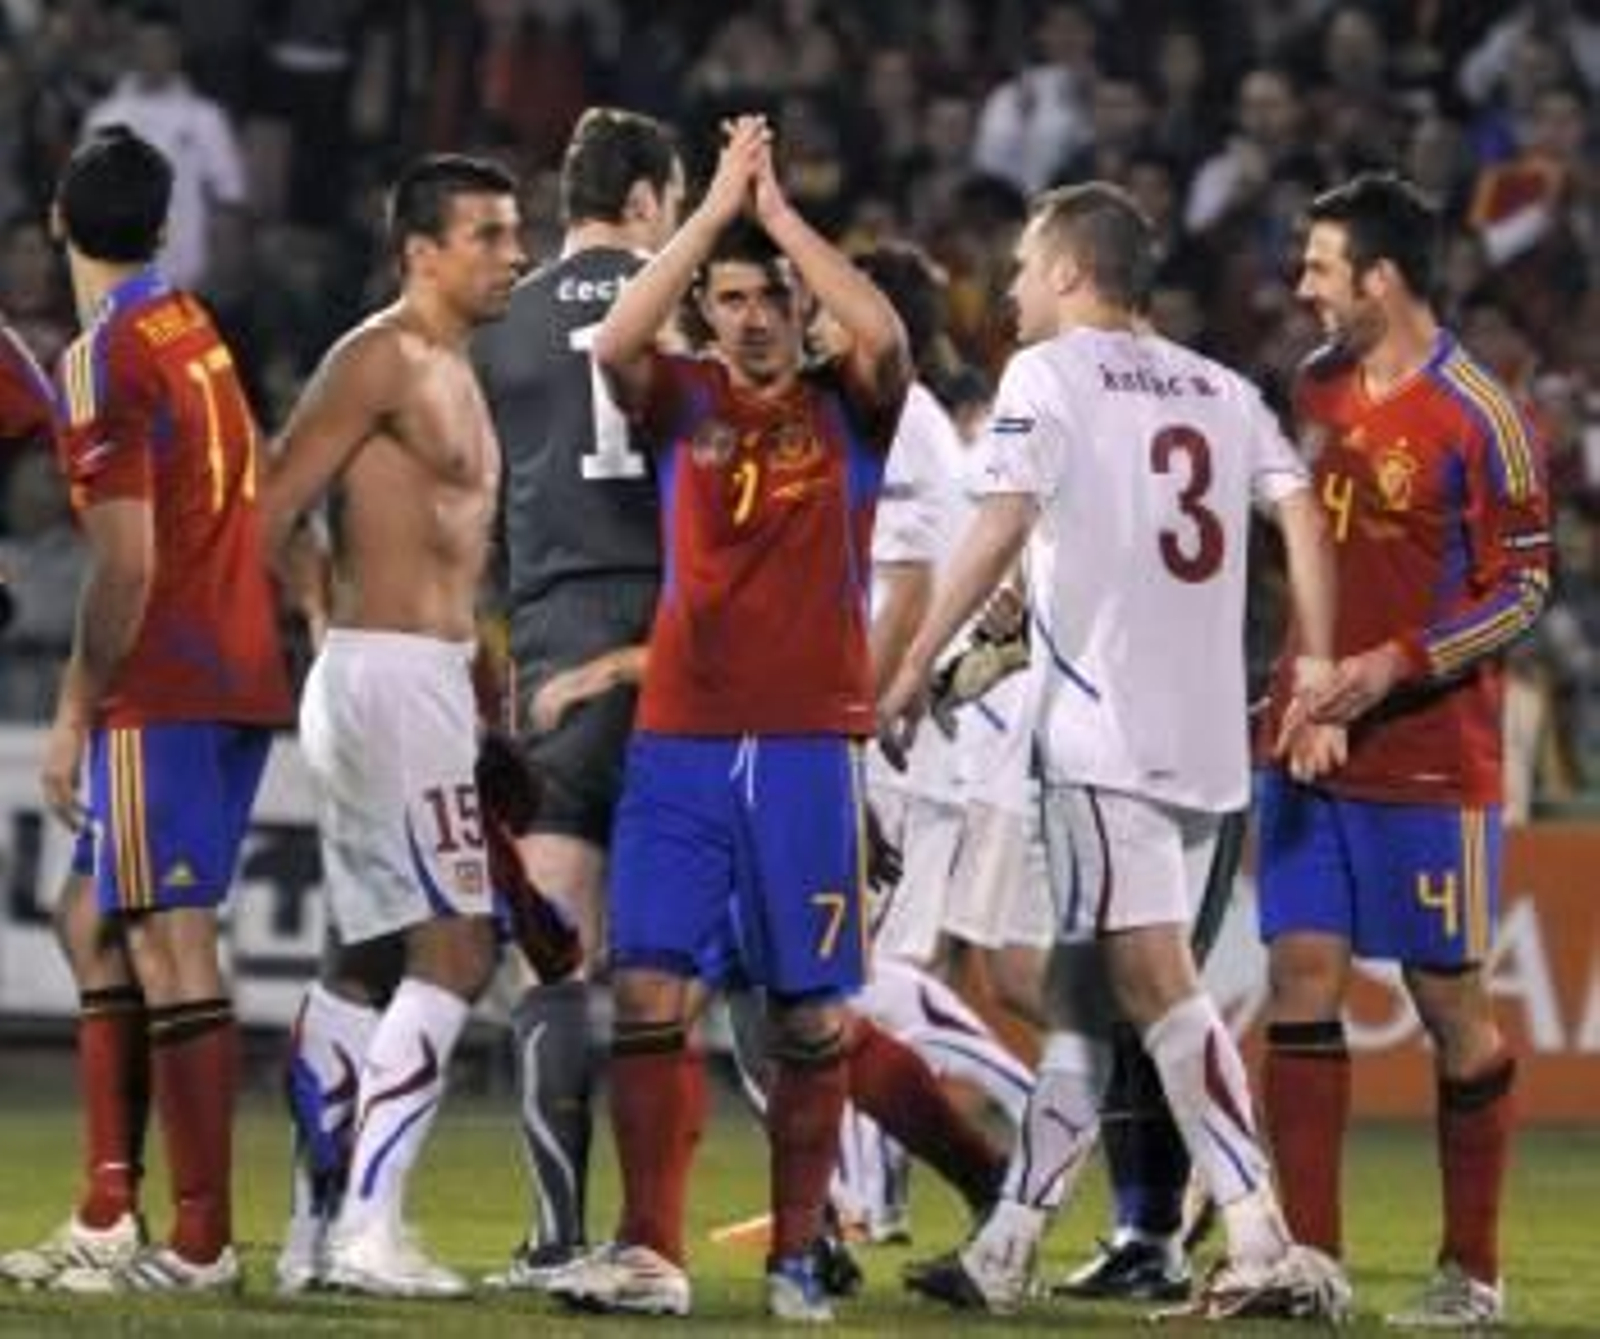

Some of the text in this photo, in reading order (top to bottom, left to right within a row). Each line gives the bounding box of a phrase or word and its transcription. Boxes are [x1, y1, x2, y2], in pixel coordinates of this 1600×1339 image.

[569, 324, 645, 478] 1
[1150, 425, 1224, 583] 3
[1323, 473, 1353, 542] 4
[424, 784, 484, 852] 15
[811, 893, 845, 958] 7
[1416, 872, 1456, 938] 4
